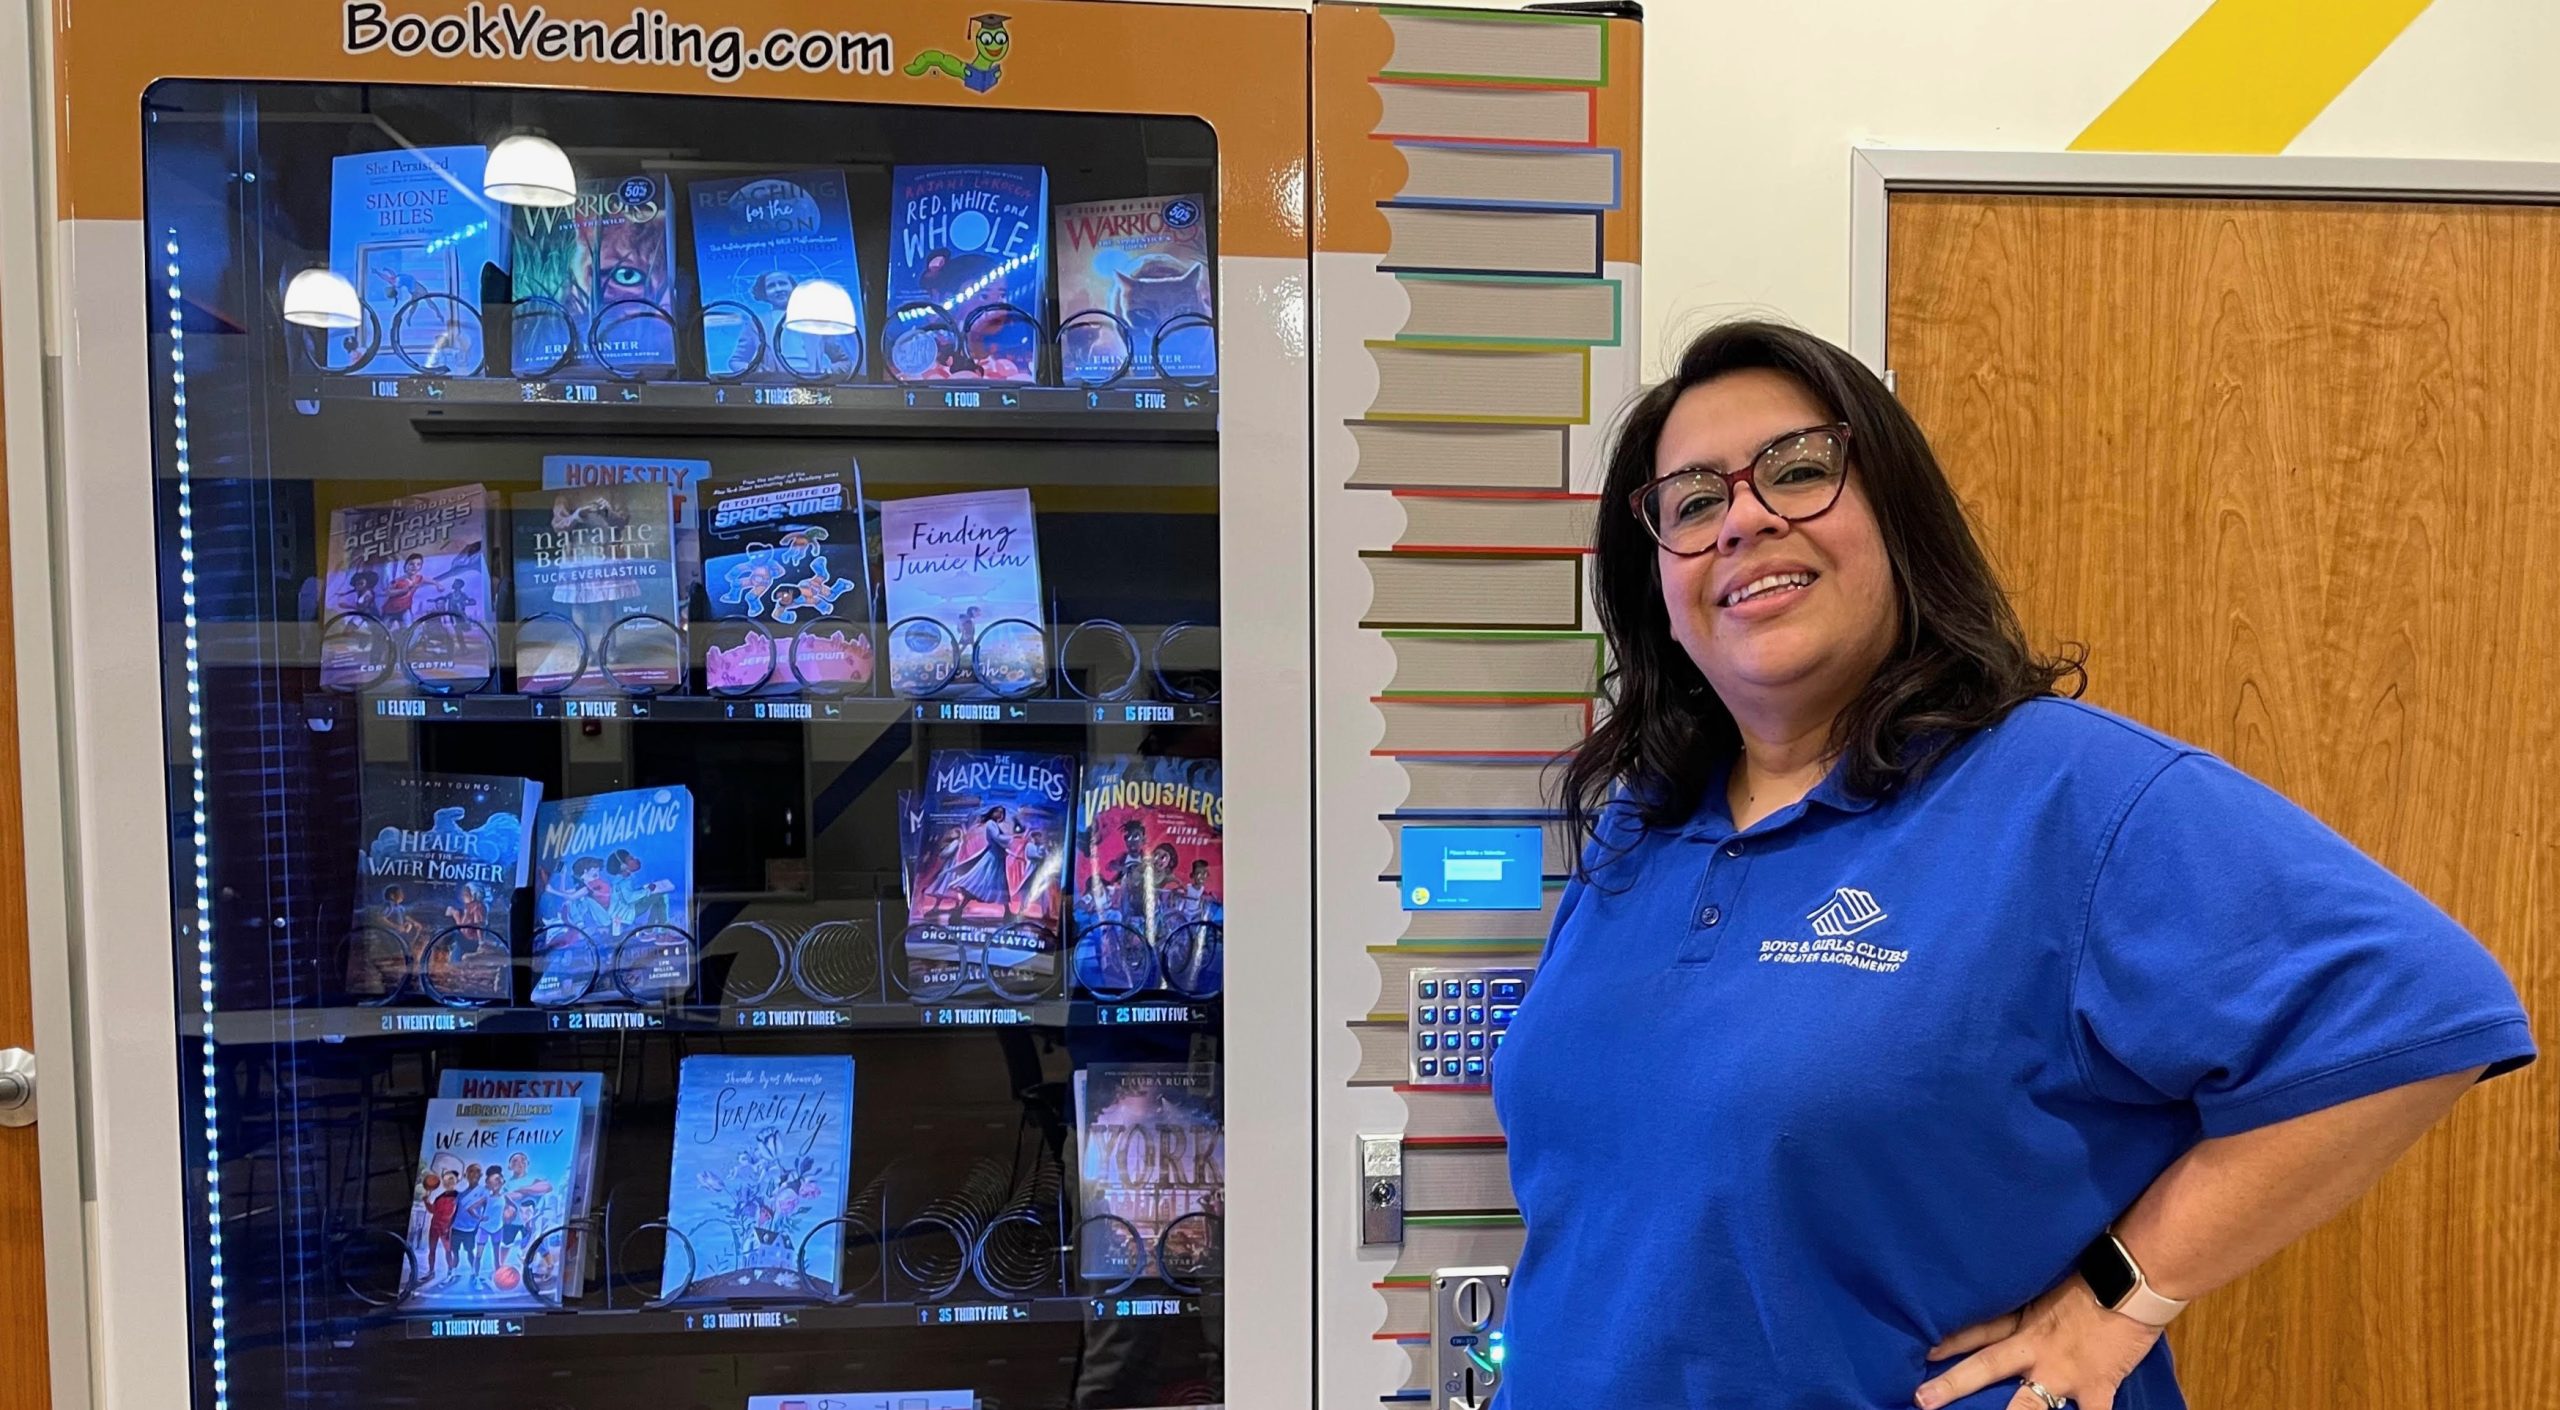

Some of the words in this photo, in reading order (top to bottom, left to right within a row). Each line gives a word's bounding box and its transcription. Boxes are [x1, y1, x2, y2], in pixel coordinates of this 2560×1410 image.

[345, 3, 891, 76] BookVending.com
[366, 162, 389, 176] She
[366, 188, 449, 210] SIMONE
[951, 190, 1000, 214] WHITE,
[1003, 204, 1029, 217] and
[768, 199, 793, 219] the
[379, 208, 434, 227] BILES
[602, 217, 625, 226] WILD
[903, 210, 1029, 268] WHOLE
[544, 344, 577, 354] ERI
[583, 341, 639, 353] HNTER
[379, 381, 399, 397] ONE
[566, 386, 573, 400] 2
[575, 386, 597, 401] TWO
[754, 389, 763, 404] 3
[945, 393, 952, 407] 4
[954, 393, 980, 407] FOUR
[1135, 393, 1143, 408] 5
[1144, 393, 1166, 409] FIVE
[566, 463, 690, 490] HONESTLY
[721, 501, 730, 509] A
[734, 496, 770, 508] TOTAL
[775, 489, 819, 501] WASTE
[822, 486, 840, 495] OF
[714, 494, 842, 527] SPACE-TIME!
[344, 526, 388, 550] ACE
[394, 502, 472, 533] TAKES
[912, 515, 1018, 553] Finding
[363, 524, 454, 562] FLIGHT
[893, 552, 968, 582] Junie
[973, 543, 1030, 573] Kim
[533, 573, 567, 584] TUCK
[571, 565, 657, 581] EVERLASTING
[388, 700, 426, 716] ELEVEN
[566, 701, 577, 716] 12
[580, 701, 617, 717] TWELVE
[754, 703, 766, 718] 13
[768, 703, 812, 719] THIRTEEN
[940, 704, 951, 719] 14
[953, 704, 1001, 720] FOURTEEN
[1125, 706, 1136, 721] 15
[1137, 706, 1174, 721] FIFTEEN
[994, 755, 1011, 765] THE
[448, 782, 490, 791] YOUNG
[936, 762, 1065, 801] MARVELLERS
[1101, 773, 1118, 785] THE
[1085, 780, 1224, 828] VANQUISHERS
[400, 829, 481, 857] HEALER
[368, 857, 424, 877] WATER
[428, 860, 504, 883] MONSTER
[1760, 940, 1798, 952] BOYS
[1800, 940, 1810, 952] &
[1812, 939, 1856, 952] GIRLS
[1856, 942, 1909, 963] CLUBS
[1759, 953, 1773, 962] OF
[1774, 952, 1819, 963] GREATER
[1820, 952, 1900, 973] SACRAMENTO
[1425, 984, 1432, 994] 1
[1448, 984, 1457, 995] 2
[1471, 984, 1480, 995] 3
[381, 1016, 393, 1030] 21
[397, 1015, 436, 1030] TWENTY
[437, 1015, 455, 1030] ONE
[569, 1013, 583, 1028] 22
[585, 1013, 623, 1028] TWENTY
[624, 1012, 645, 1028] TWO
[752, 1011, 766, 1026] 23
[768, 1011, 806, 1026] TWENTY
[807, 1011, 836, 1026] THREE
[939, 1009, 952, 1024] 24
[955, 1009, 992, 1024] TWENTY
[993, 1008, 1017, 1024] FOUR
[1116, 1007, 1130, 1022] 25
[1132, 1007, 1168, 1022] TWENTY
[1169, 1007, 1189, 1022] FIVE
[1424, 1011, 1432, 1021] 4
[1448, 1010, 1456, 1021] 5
[1471, 1010, 1480, 1021] 6
[1425, 1036, 1432, 1047] 7
[1471, 1036, 1480, 1046] 9
[1447, 1063, 1457, 1073] 0
[1121, 1077, 1163, 1086] LAURA
[1166, 1077, 1198, 1086] RUBY
[786, 1090, 828, 1156] Lily
[436, 1128, 464, 1149] WE
[467, 1129, 500, 1149] ARE
[506, 1127, 564, 1148] FAMILY
[1089, 1123, 1224, 1189] YORK
[938, 1308, 952, 1322] 35
[954, 1306, 988, 1321] THIRTY
[988, 1306, 1008, 1320] FIVE
[1116, 1301, 1130, 1315] 36
[1132, 1301, 1164, 1315] THIRTY
[1164, 1300, 1180, 1315] SIX
[431, 1321, 443, 1336] 31
[445, 1320, 480, 1336] THIRTY
[480, 1320, 500, 1335] ONE
[702, 1315, 716, 1329] 33
[718, 1314, 751, 1328] THIRTY
[752, 1313, 781, 1328] THREE
